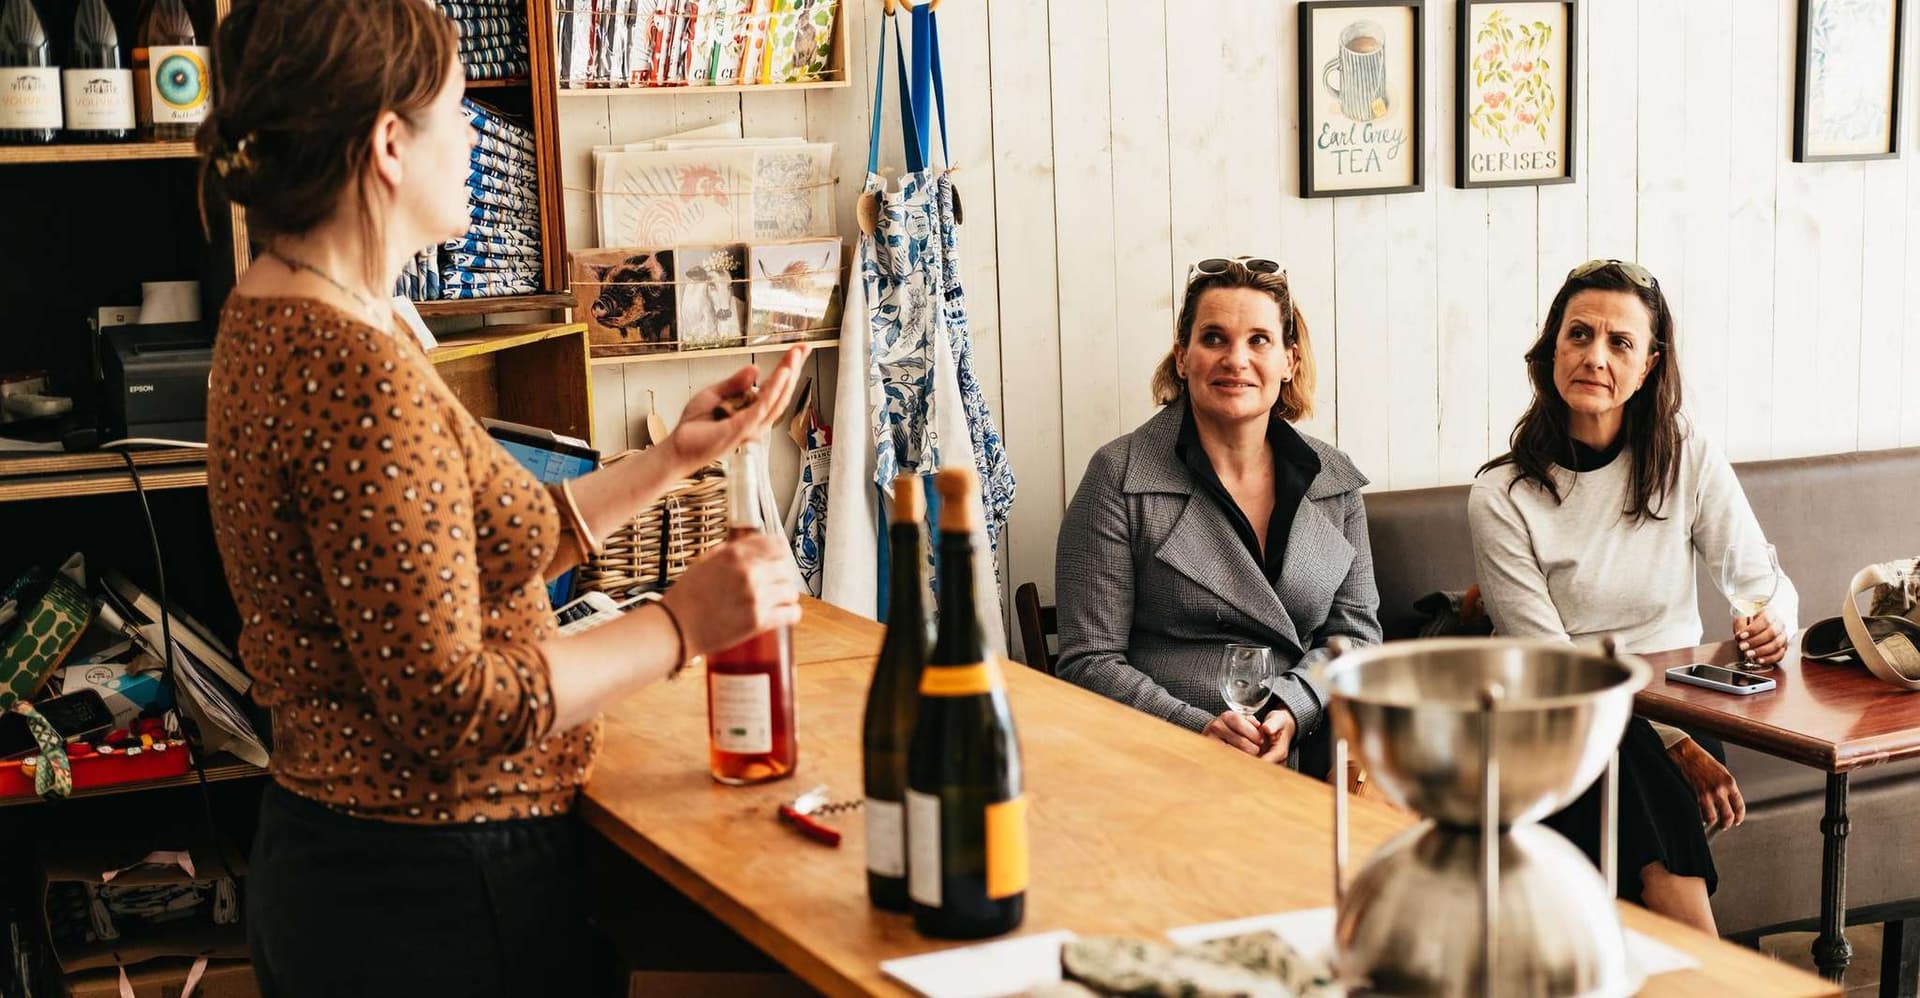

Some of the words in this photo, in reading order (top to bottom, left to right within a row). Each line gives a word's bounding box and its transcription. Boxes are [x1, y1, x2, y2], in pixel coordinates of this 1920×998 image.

[1317, 122, 1357, 149] Earl
[1363, 122, 1408, 160] Grey
[1330, 147, 1382, 175] TEA
[1471, 150, 1557, 174] CERISES
[129, 384, 154, 393] EPSON
